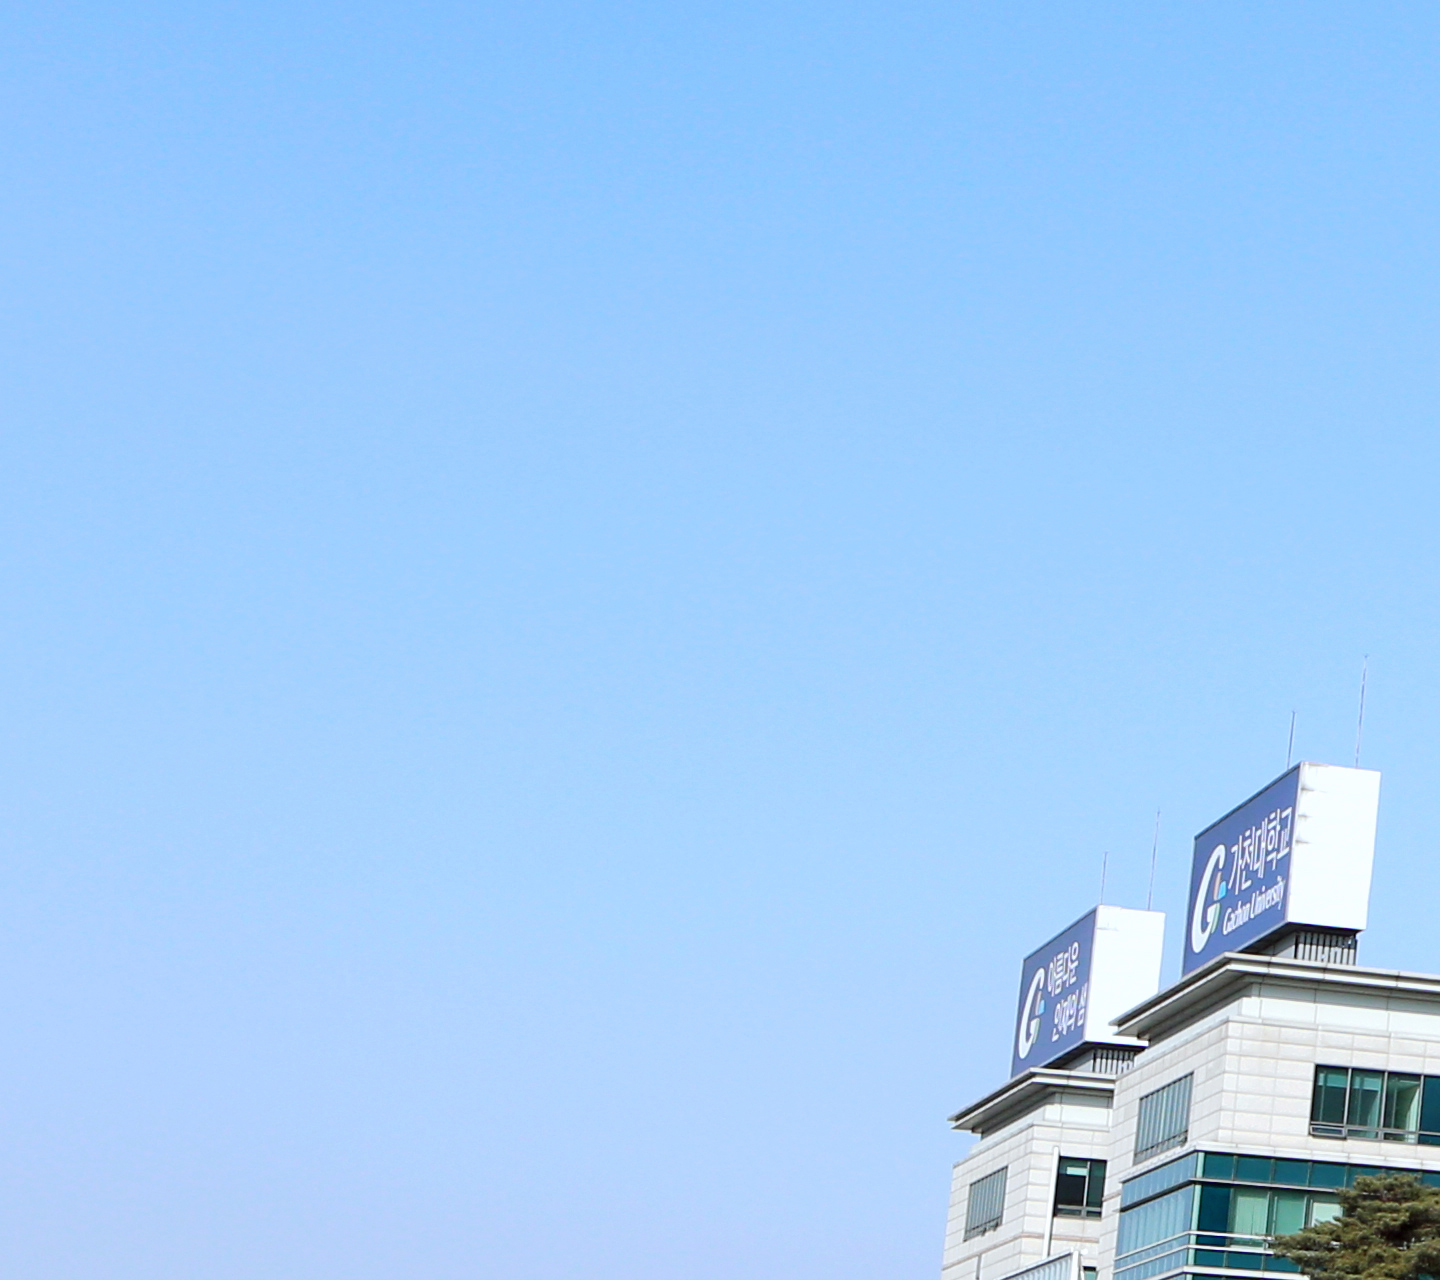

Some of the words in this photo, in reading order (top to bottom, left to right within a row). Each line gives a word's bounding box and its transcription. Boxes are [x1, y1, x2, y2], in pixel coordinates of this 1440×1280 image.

[1228, 806, 1293, 895] 가천대학교
[1223, 900, 1251, 935] Gachon
[1249, 875, 1286, 919] University
[1047, 941, 1079, 997] 아름다운
